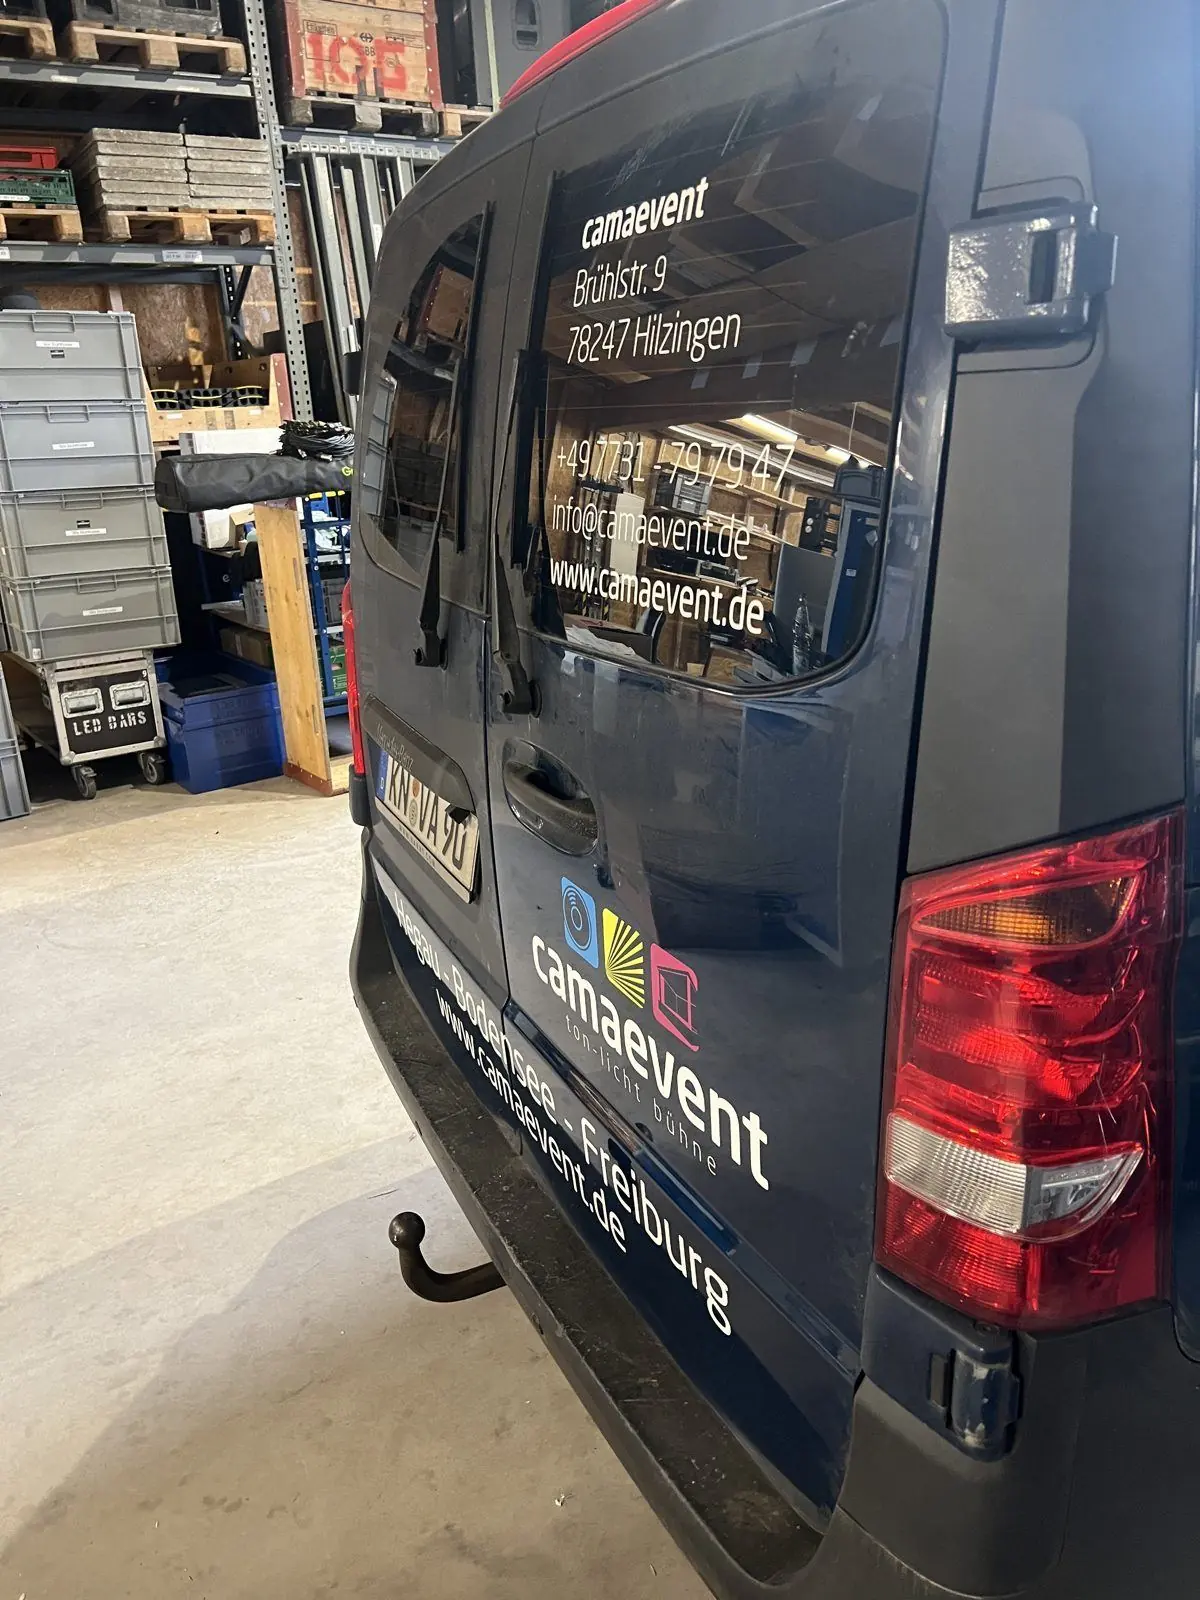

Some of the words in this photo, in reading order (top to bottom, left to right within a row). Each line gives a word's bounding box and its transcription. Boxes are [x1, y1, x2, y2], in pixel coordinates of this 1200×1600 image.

[581, 176, 709, 250] camaevent
[573, 262, 648, 308] Brühlstr.
[652, 255, 667, 292] 9
[567, 318, 630, 364] 78247
[632, 310, 741, 363] Hilzingen
[552, 494, 750, 560] info@camaevent.de
[550, 557, 765, 635] www.camaevent.de
[72, 718, 103, 736] LED
[107, 710, 147, 730] BARS
[388, 756, 412, 817] KN
[419, 781, 440, 847] VA
[531, 934, 770, 1191] camaevent
[564, 1013, 641, 1103] ton-licht
[652, 1097, 718, 1176] bühne
[394, 890, 442, 981] Hegau
[451, 964, 558, 1125] Bodensee
[580, 1116, 732, 1336] Freiburg
[435, 988, 627, 1253] www.camaevent.de
